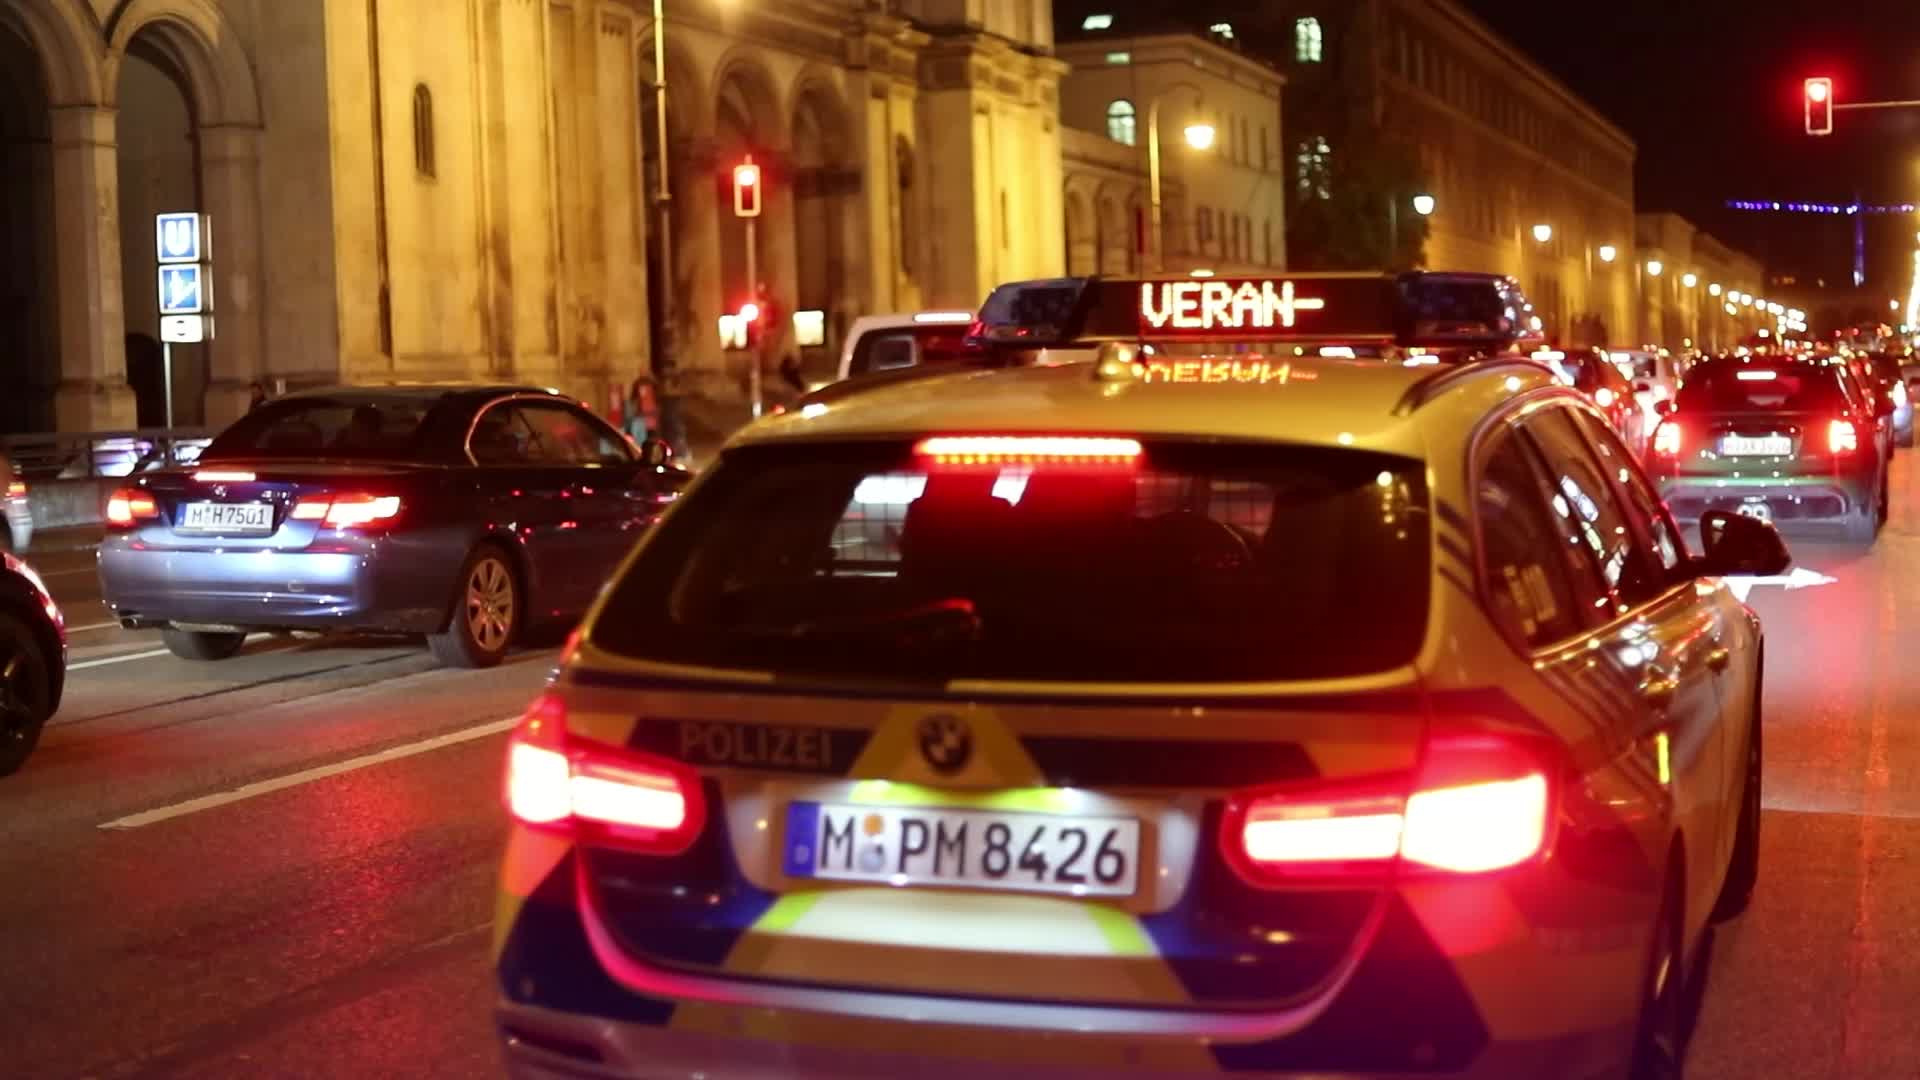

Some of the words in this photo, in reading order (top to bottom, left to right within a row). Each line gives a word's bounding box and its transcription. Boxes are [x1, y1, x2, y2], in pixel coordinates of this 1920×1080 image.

[165, 220, 191, 256] U
[1142, 280, 1325, 329] VERAN-
[192, 508, 202, 523] M
[212, 507, 223, 524] H
[227, 507, 265, 525] 7501
[680, 721, 831, 767] POLIZEI
[820, 815, 855, 870] M
[898, 818, 968, 877] PM
[981, 822, 1126, 885] 8426
